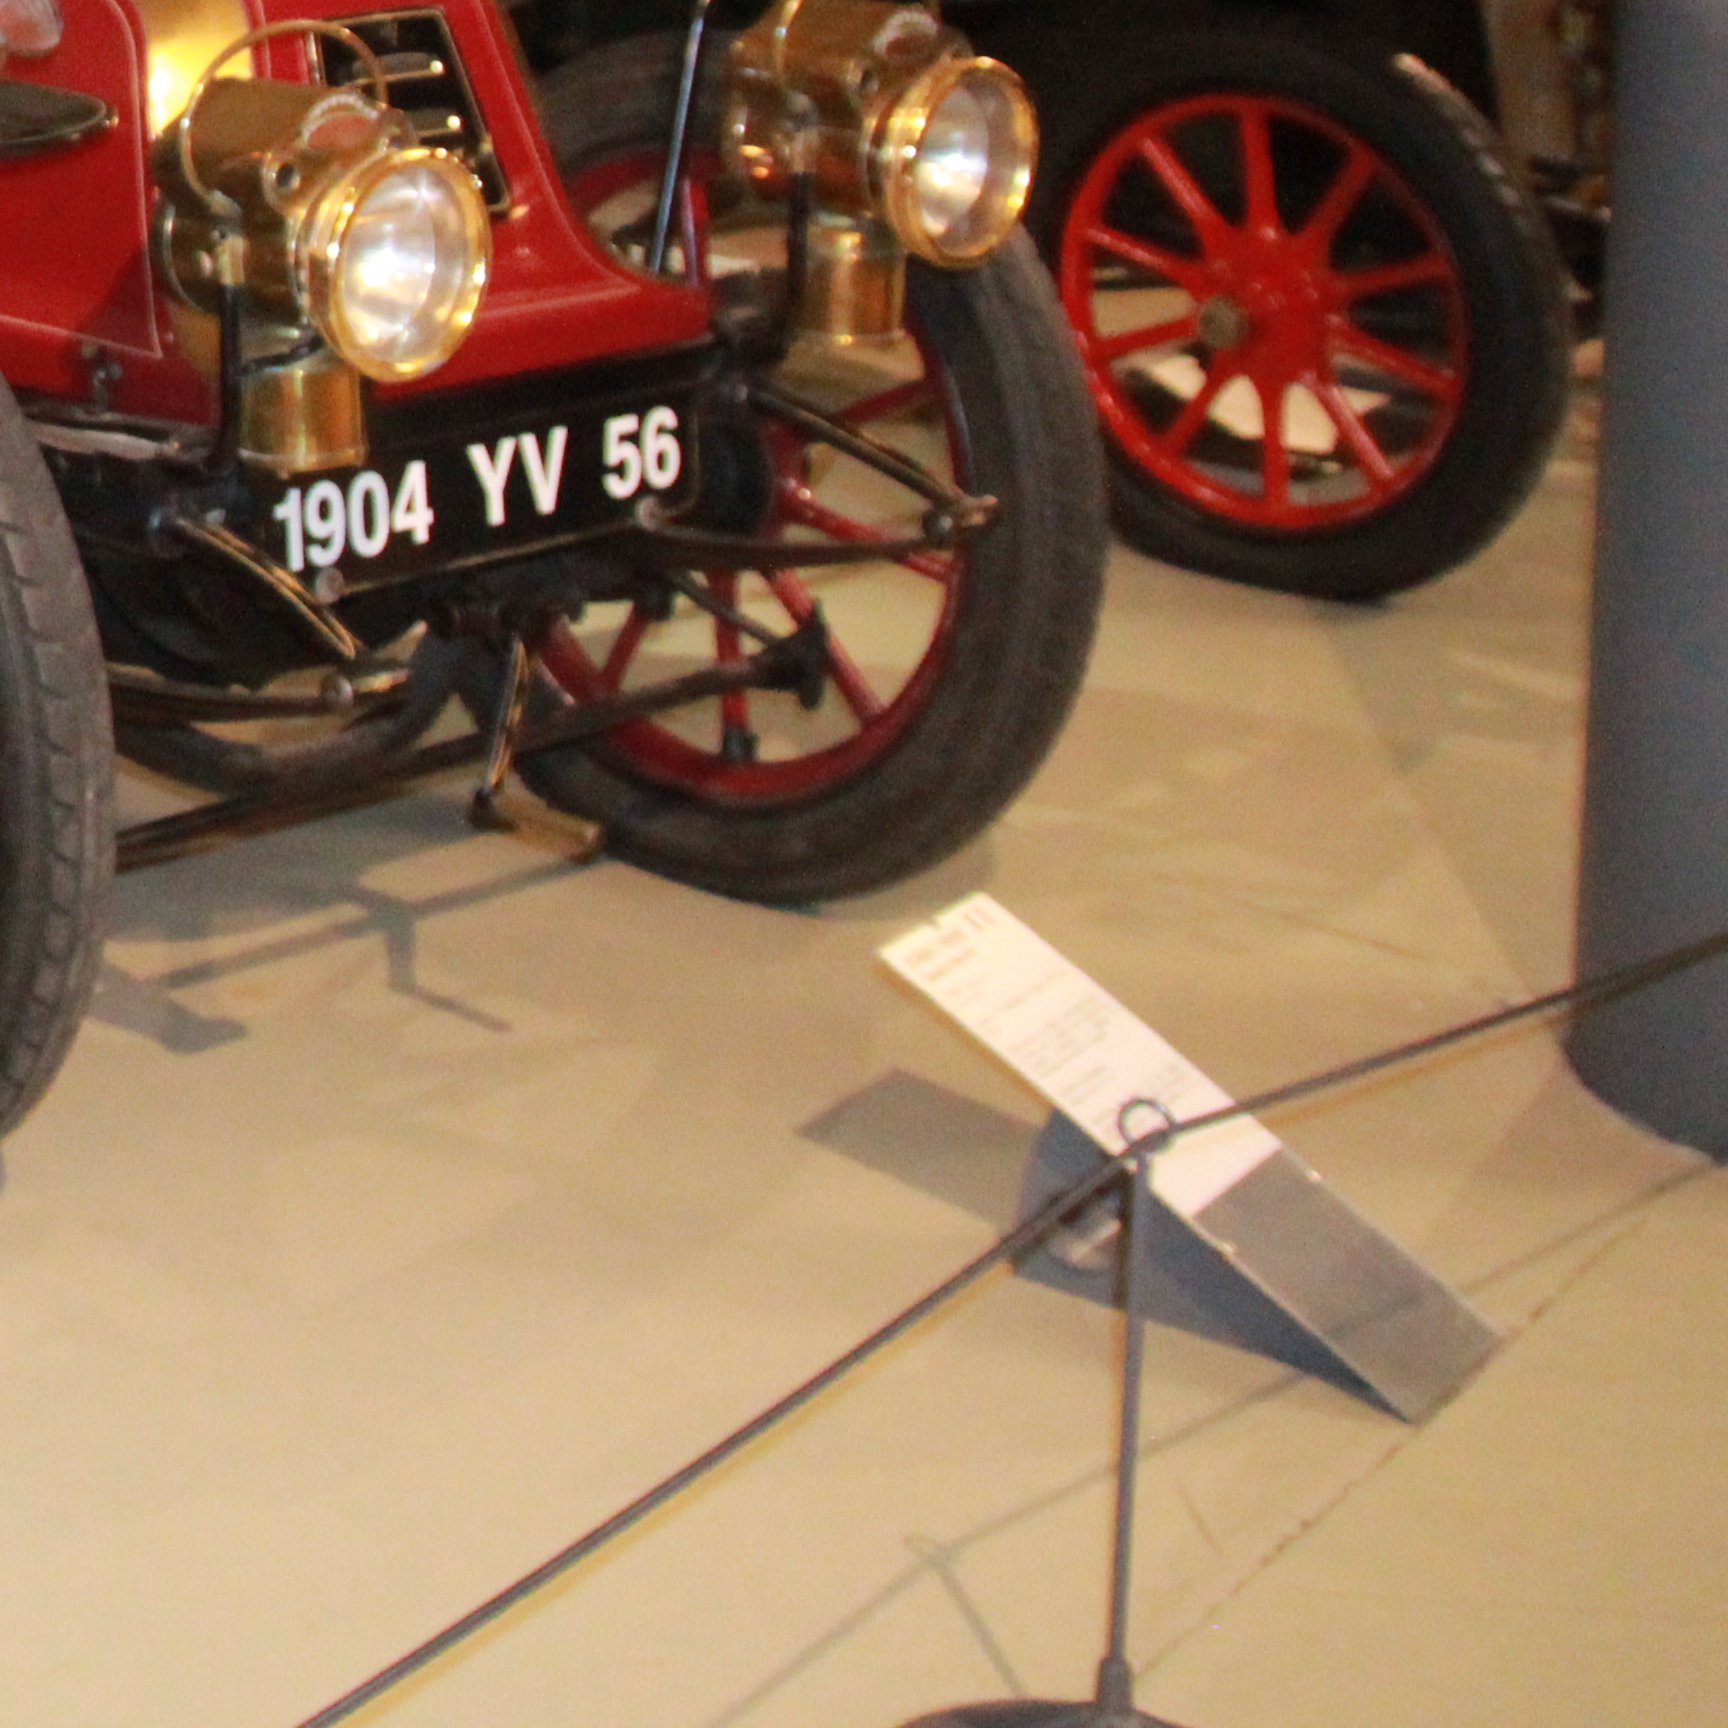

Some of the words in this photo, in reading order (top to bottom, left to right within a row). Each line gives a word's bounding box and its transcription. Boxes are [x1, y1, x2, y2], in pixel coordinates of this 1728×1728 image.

[273, 460, 435, 572] 1904
[466, 425, 569, 527] YV
[601, 405, 682, 500] 56
